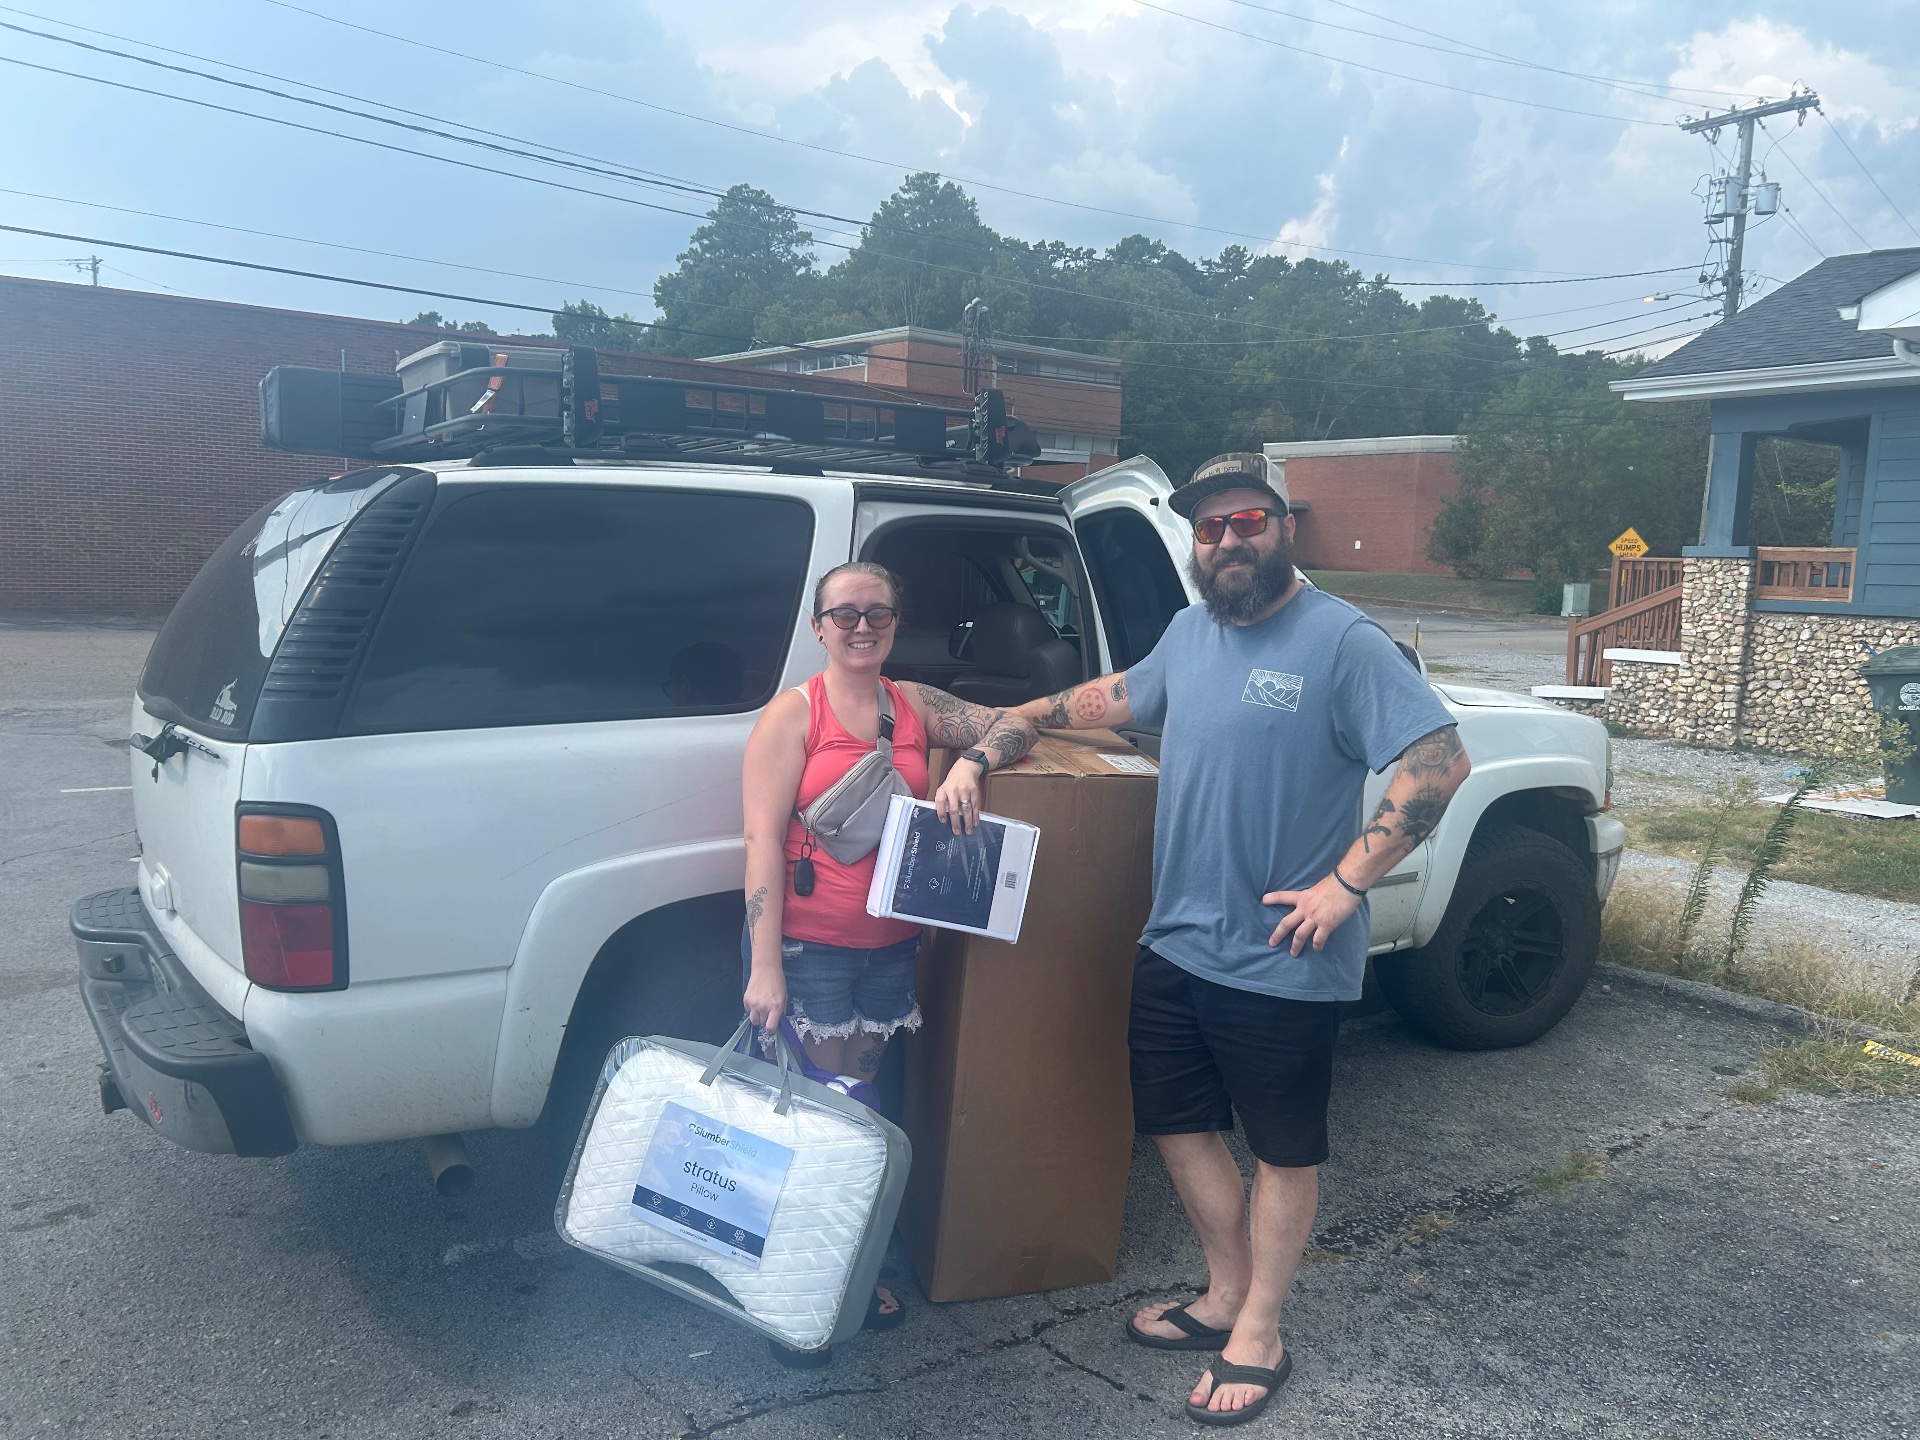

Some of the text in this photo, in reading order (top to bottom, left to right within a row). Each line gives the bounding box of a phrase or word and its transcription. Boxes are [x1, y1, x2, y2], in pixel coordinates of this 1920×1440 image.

[1615, 544, 1641, 552] HUMPS
[694, 1126, 758, 1158] SlumberShield
[683, 1161, 737, 1192] stratus
[690, 1182, 719, 1202] Pillow
